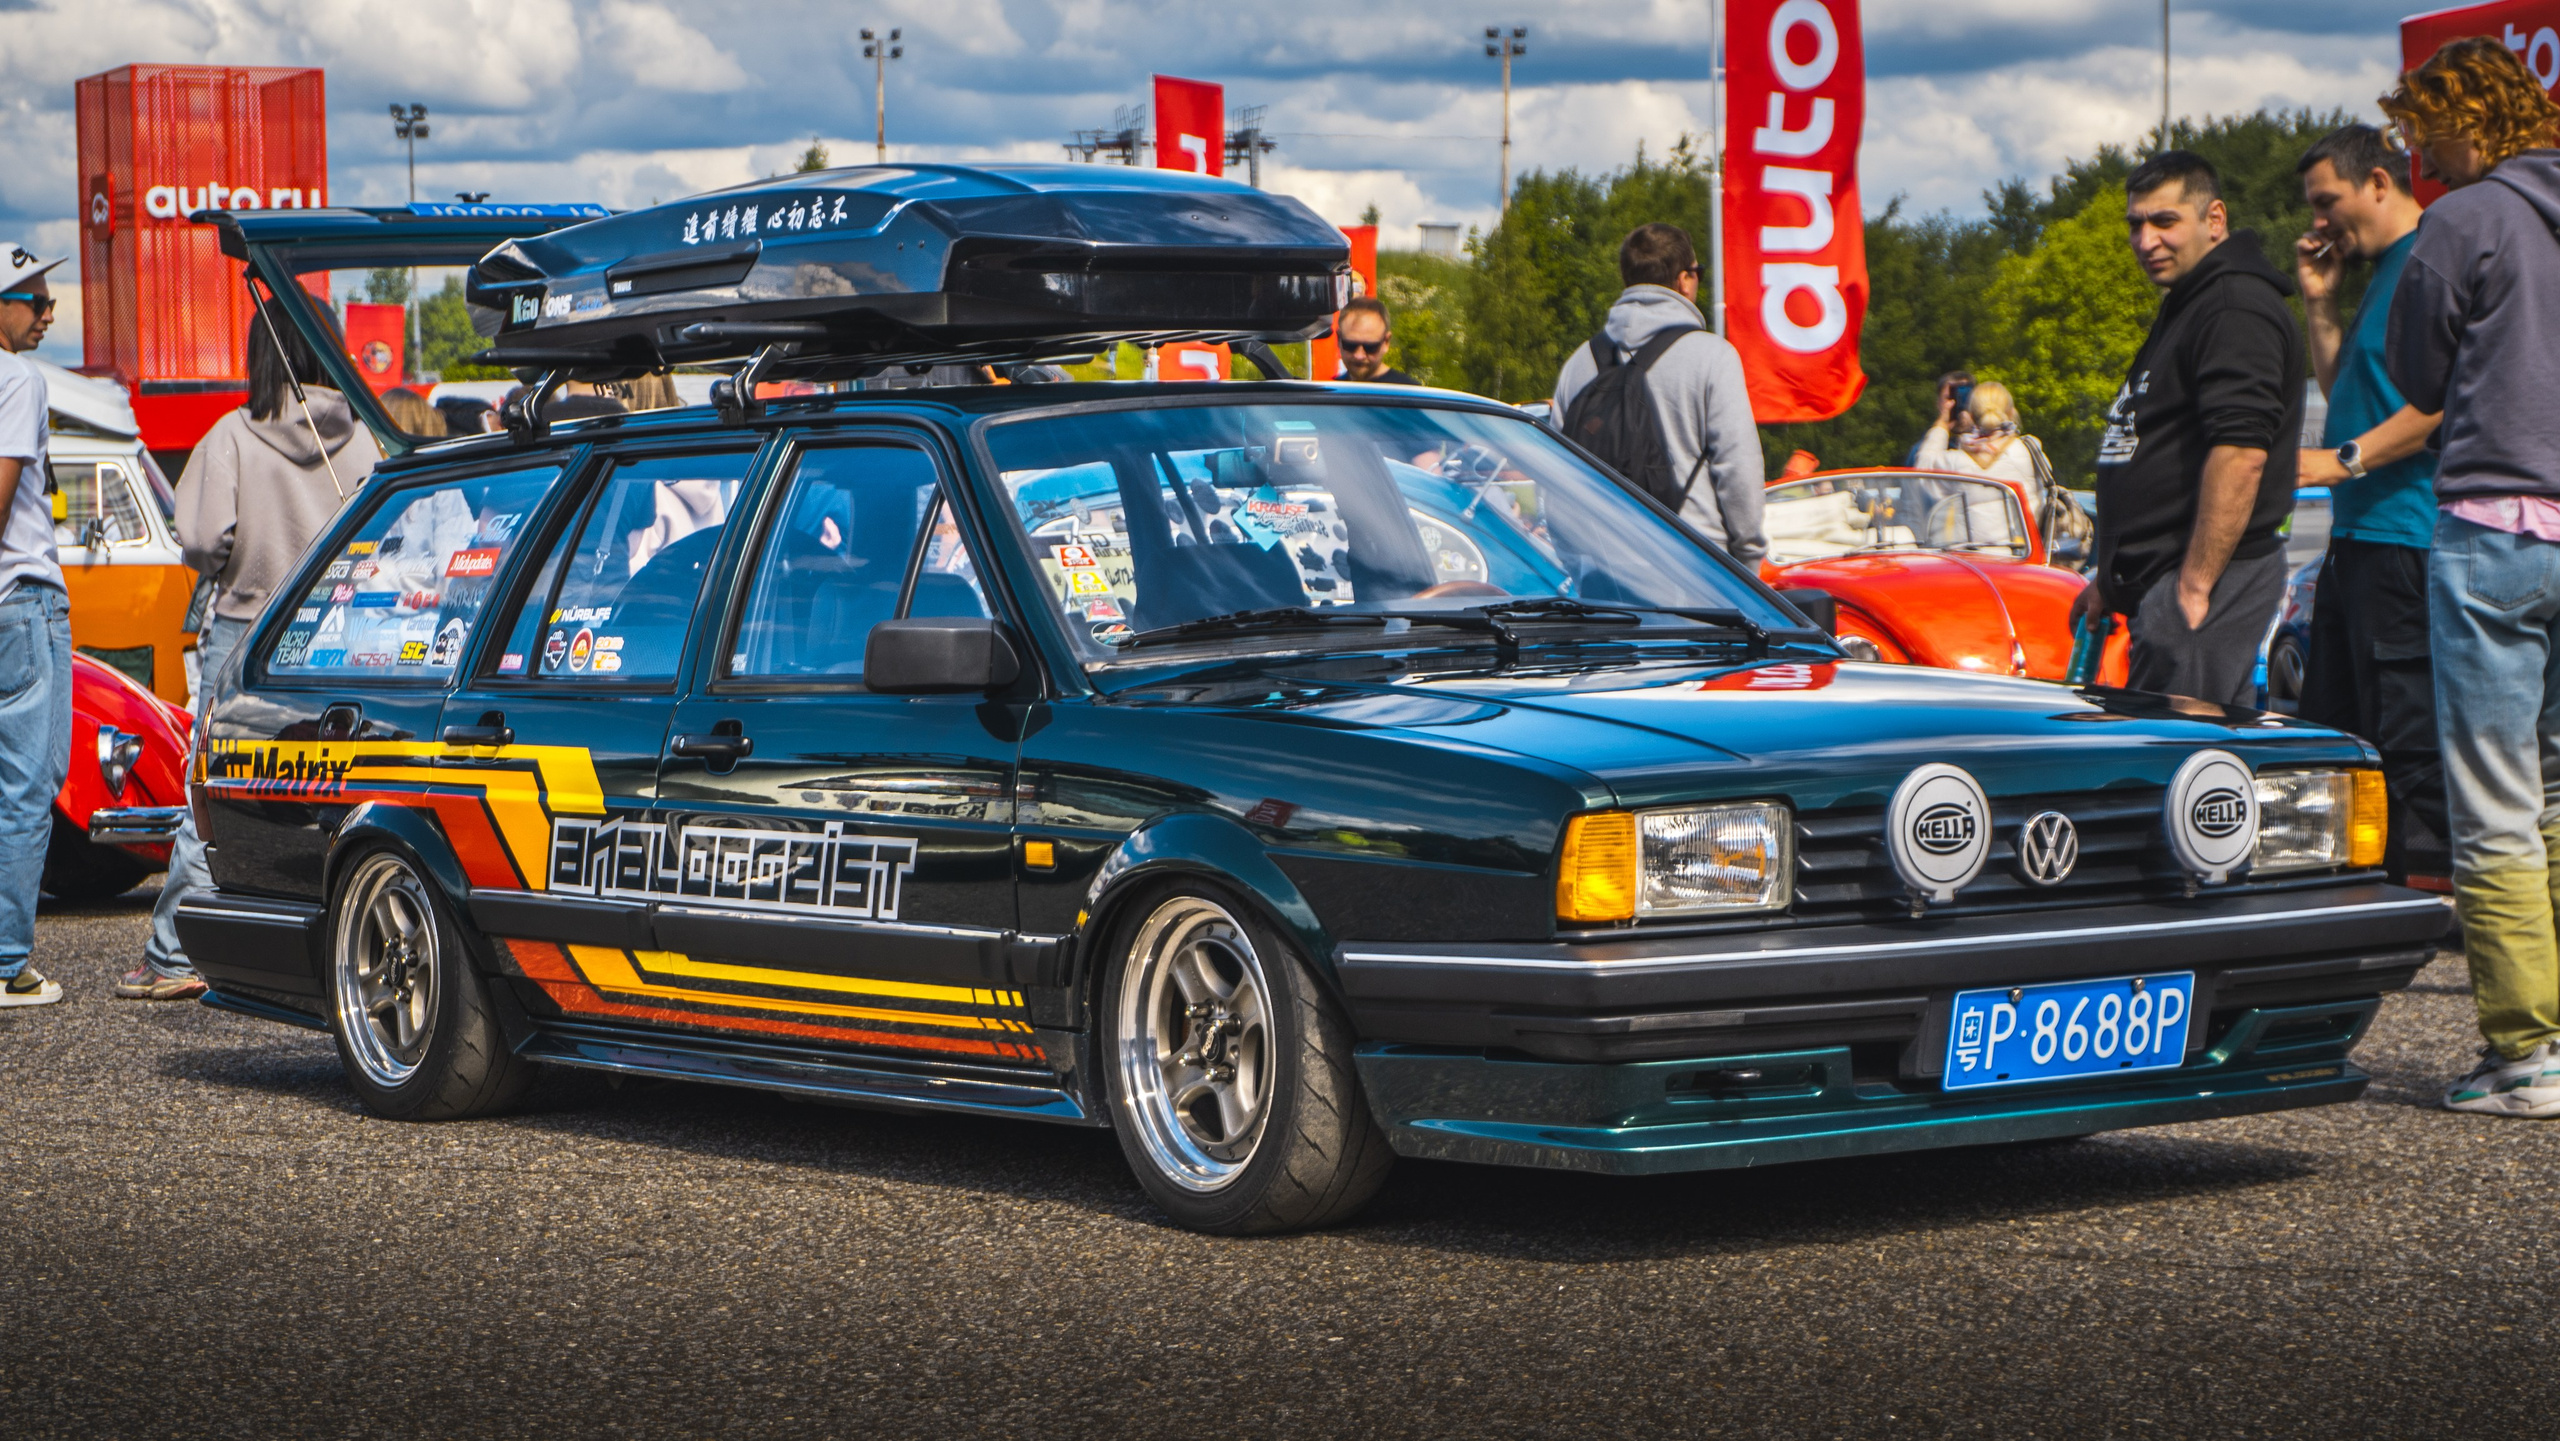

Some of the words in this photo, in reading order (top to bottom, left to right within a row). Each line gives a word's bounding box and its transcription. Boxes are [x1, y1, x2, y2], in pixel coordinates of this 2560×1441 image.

[145, 181, 321, 219] autoru
[1248, 501, 1307, 515] KRAUSE
[561, 605, 612, 622] NÜRBLIFE
[247, 747, 349, 797] Matrix
[2196, 799, 2247, 823] HELLA
[1918, 815, 1976, 840] HELLA
